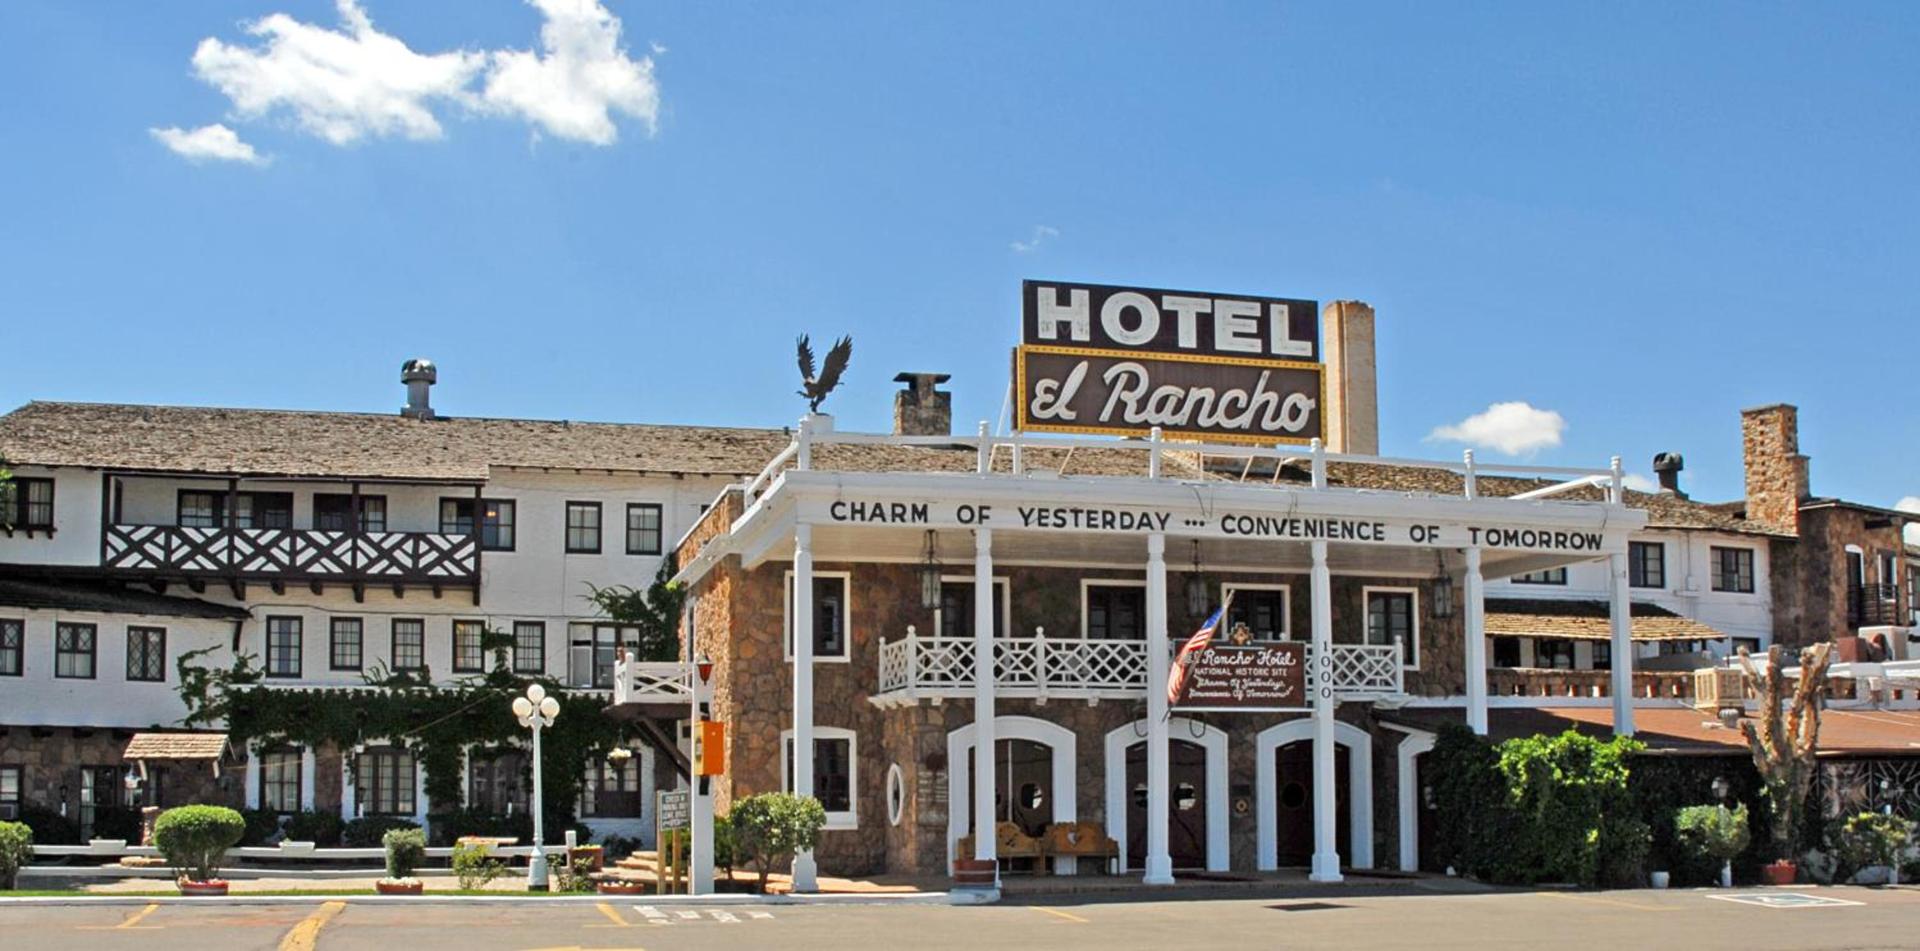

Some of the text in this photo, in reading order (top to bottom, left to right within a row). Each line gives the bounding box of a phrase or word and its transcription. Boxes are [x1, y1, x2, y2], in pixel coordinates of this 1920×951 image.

[1037, 286, 1313, 357] HOTEL
[1030, 360, 1316, 433] El Rancho
[830, 501, 929, 524] CHARM
[956, 505, 992, 525] OF
[1018, 507, 1171, 531] YESTERDAY
[1220, 514, 1386, 542] CONVENIENCE
[1409, 524, 1440, 544] OF
[1467, 527, 1603, 551] TOMORROW
[1194, 667, 1287, 677] NATIONAL HISTORIC SITE
[1202, 648, 1254, 665] Rancho
[1257, 649, 1297, 666] Hotel
